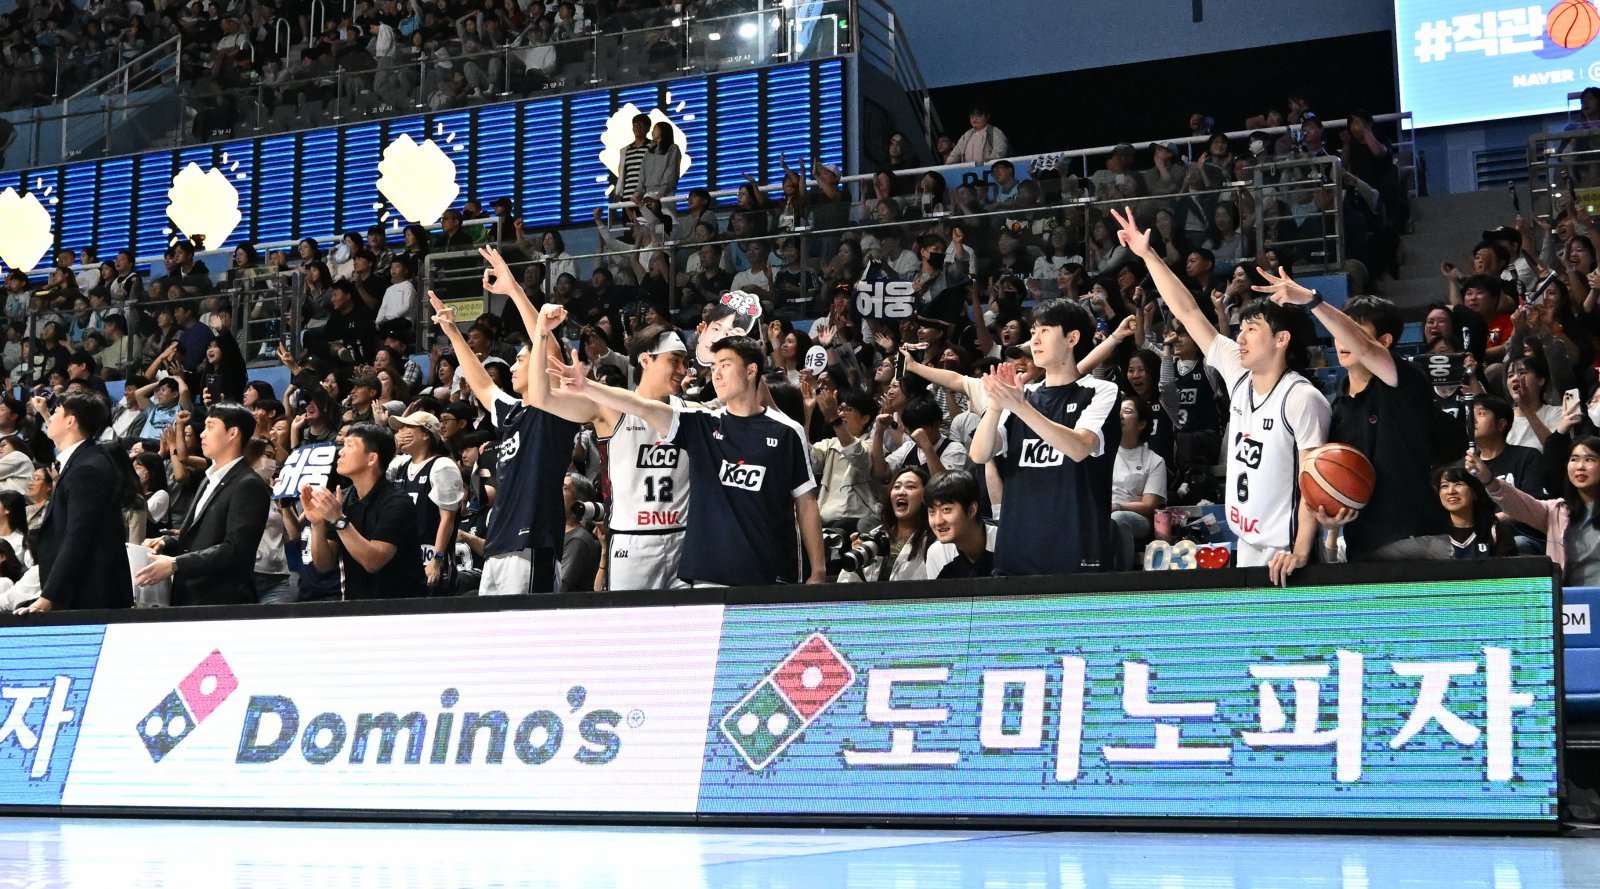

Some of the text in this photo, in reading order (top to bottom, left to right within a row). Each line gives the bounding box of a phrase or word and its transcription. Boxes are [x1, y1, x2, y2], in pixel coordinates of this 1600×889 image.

[1512, 69, 1574, 88] NAVER
[856, 280, 915, 319] 허웅
[640, 442, 678, 467] KCC
[272, 445, 337, 497] 허웅
[721, 460, 761, 488] KCC
[1237, 471, 1249, 503] 6
[643, 475, 674, 503] 12
[1143, 539, 1198, 571] 03
[235, 685, 623, 766] Domino's
[842, 645, 1535, 783] 도미노피자
